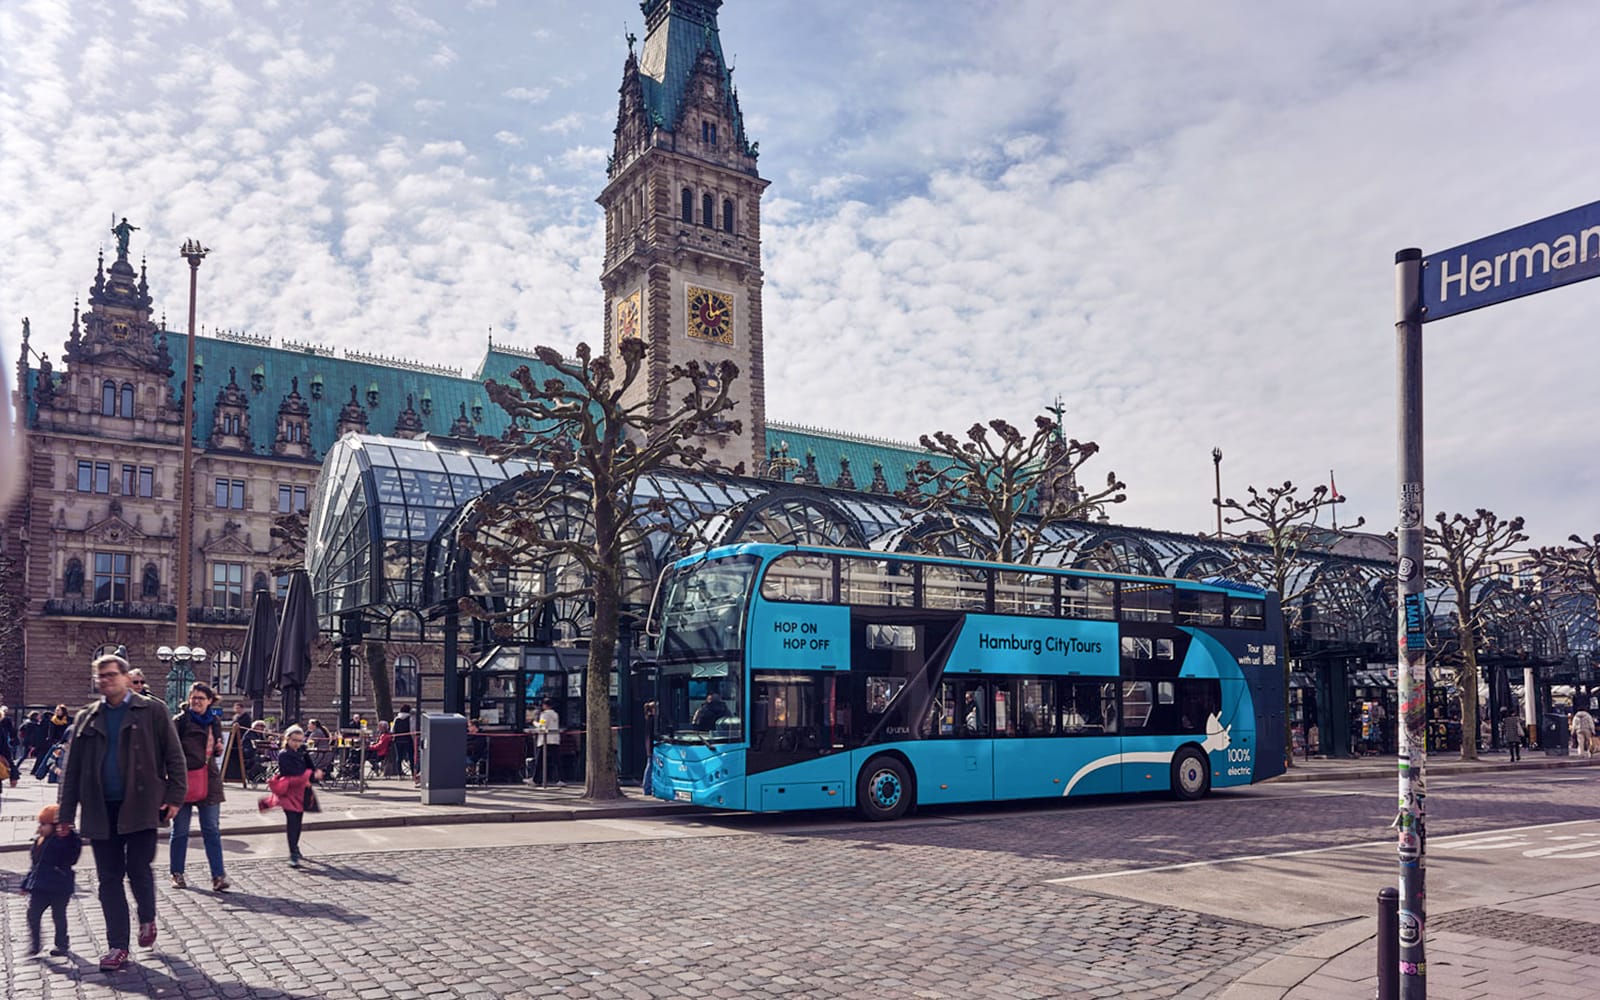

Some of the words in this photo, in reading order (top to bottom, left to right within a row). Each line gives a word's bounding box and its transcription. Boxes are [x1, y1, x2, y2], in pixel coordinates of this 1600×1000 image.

[1440, 224, 1600, 302] Herman
[774, 621, 797, 633] HOP
[801, 622, 817, 634] ON
[783, 638, 806, 649] HOP
[809, 639, 830, 650] OFF
[979, 633, 1042, 655] Hamburg
[1247, 643, 1260, 653] Tour
[1238, 655, 1251, 665] with
[1227, 748, 1251, 762] 100%
[1227, 766, 1251, 776] electric
